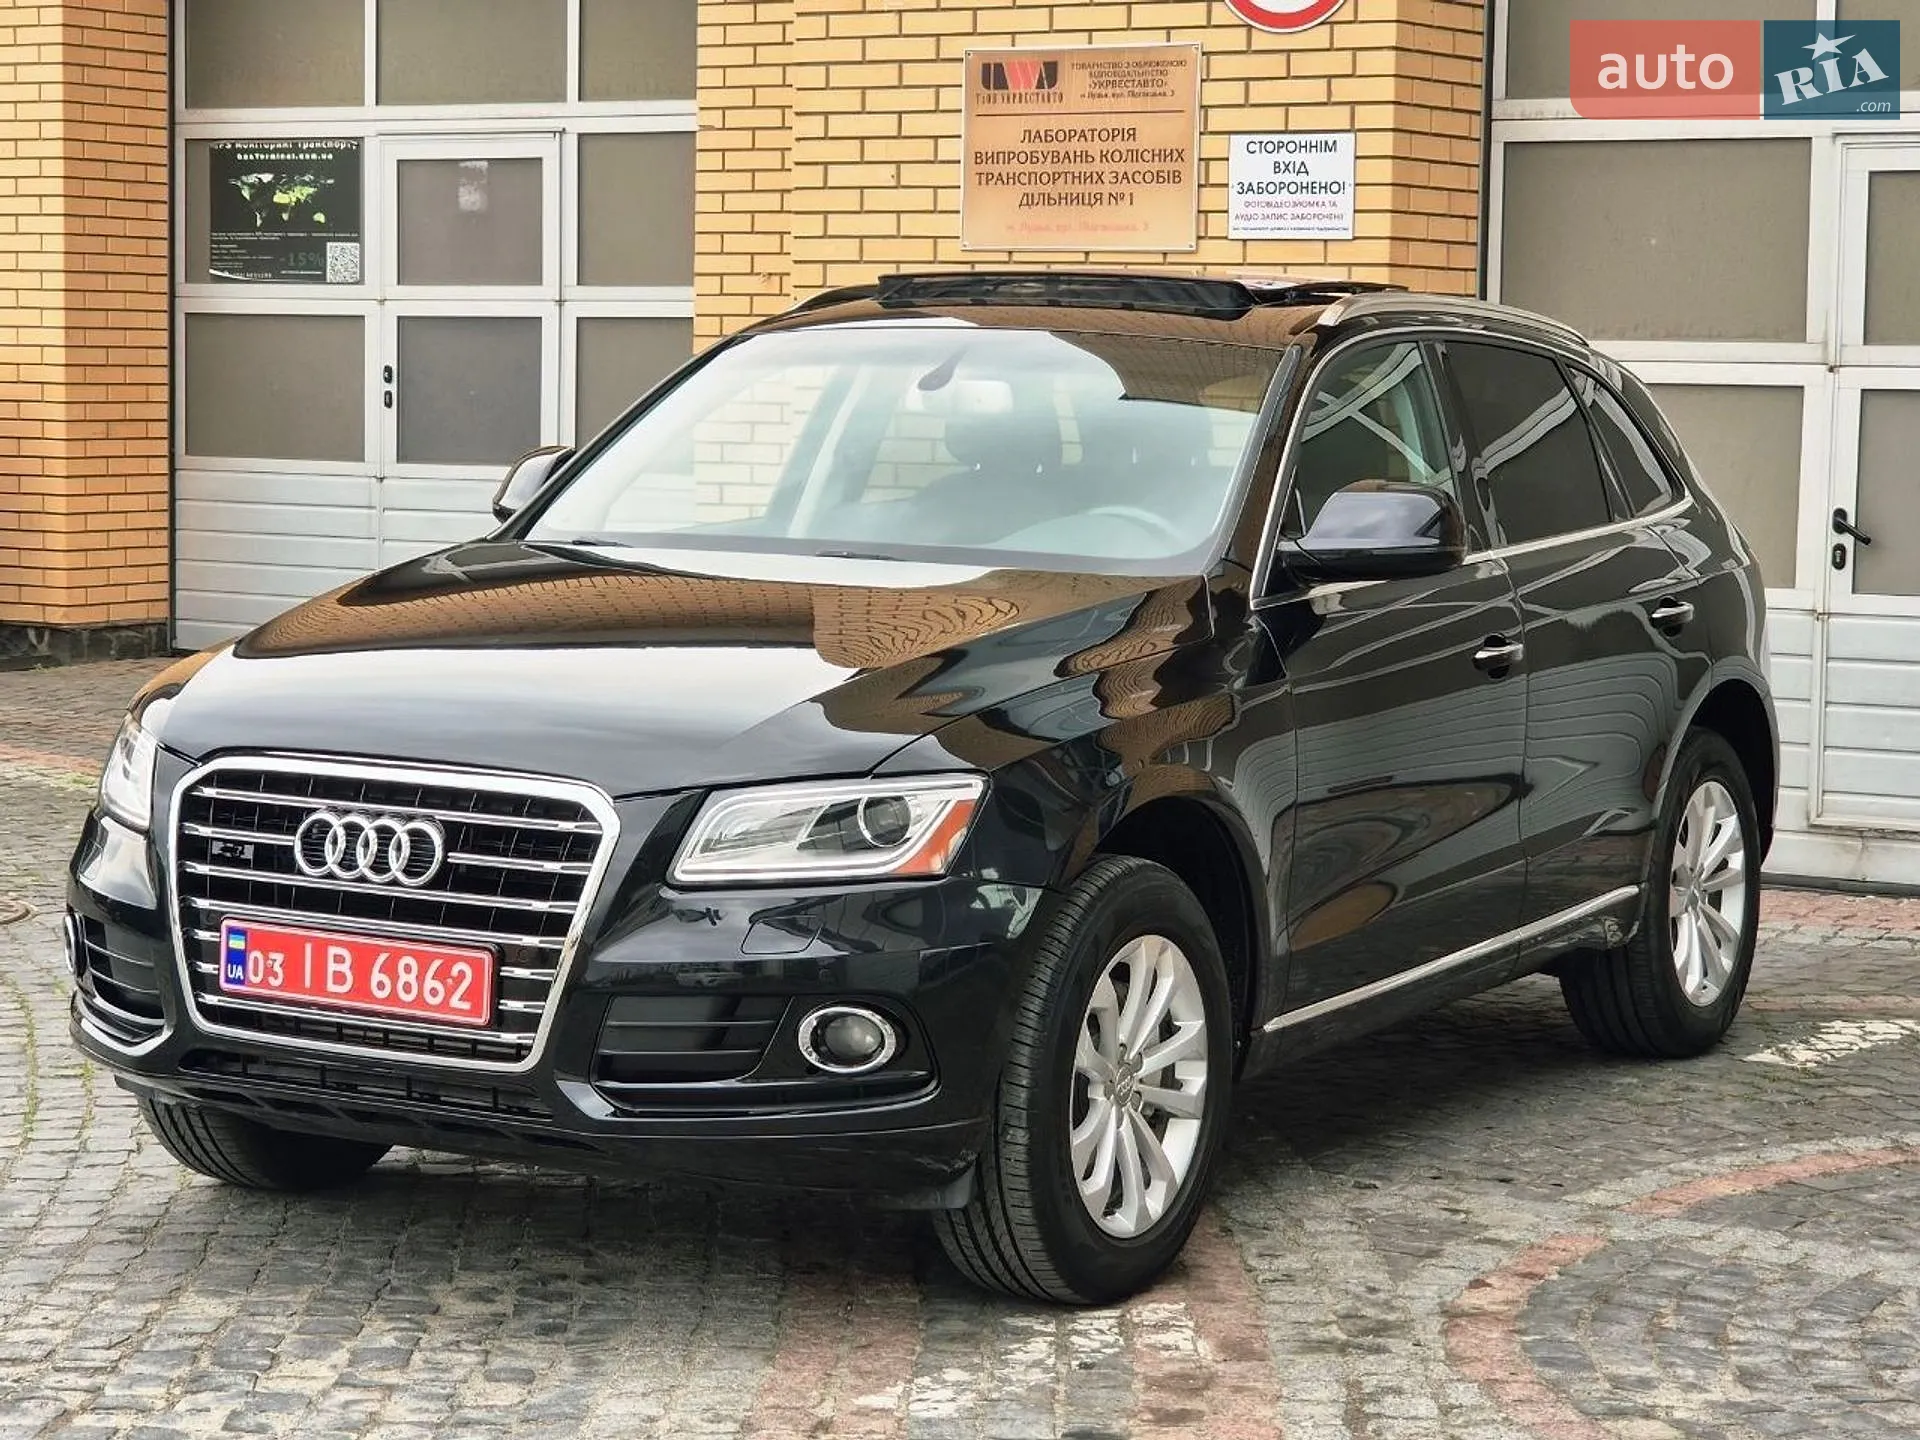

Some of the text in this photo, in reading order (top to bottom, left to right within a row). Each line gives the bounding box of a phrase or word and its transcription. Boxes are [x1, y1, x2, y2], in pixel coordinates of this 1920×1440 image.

[1020, 127, 1137, 144] ЛАБОРАТОРІЯ
[1246, 139, 1337, 154] СТОРОННІМ
[974, 148, 1185, 165] ВИПРОБУВАНЬ КОЛІСНИХ
[1273, 160, 1309, 176] ВХІД
[976, 170, 1182, 186] ТРАНСПОРТНИХ ЗАСОБІВ
[1236, 181, 1346, 195] ЗАБОРОНЕНО!
[1018, 192, 1104, 209] ДІЛЬНИЦЯ
[227, 963, 244, 981] UA
[247, 949, 284, 988] 03
[370, 952, 473, 1011] 6862
